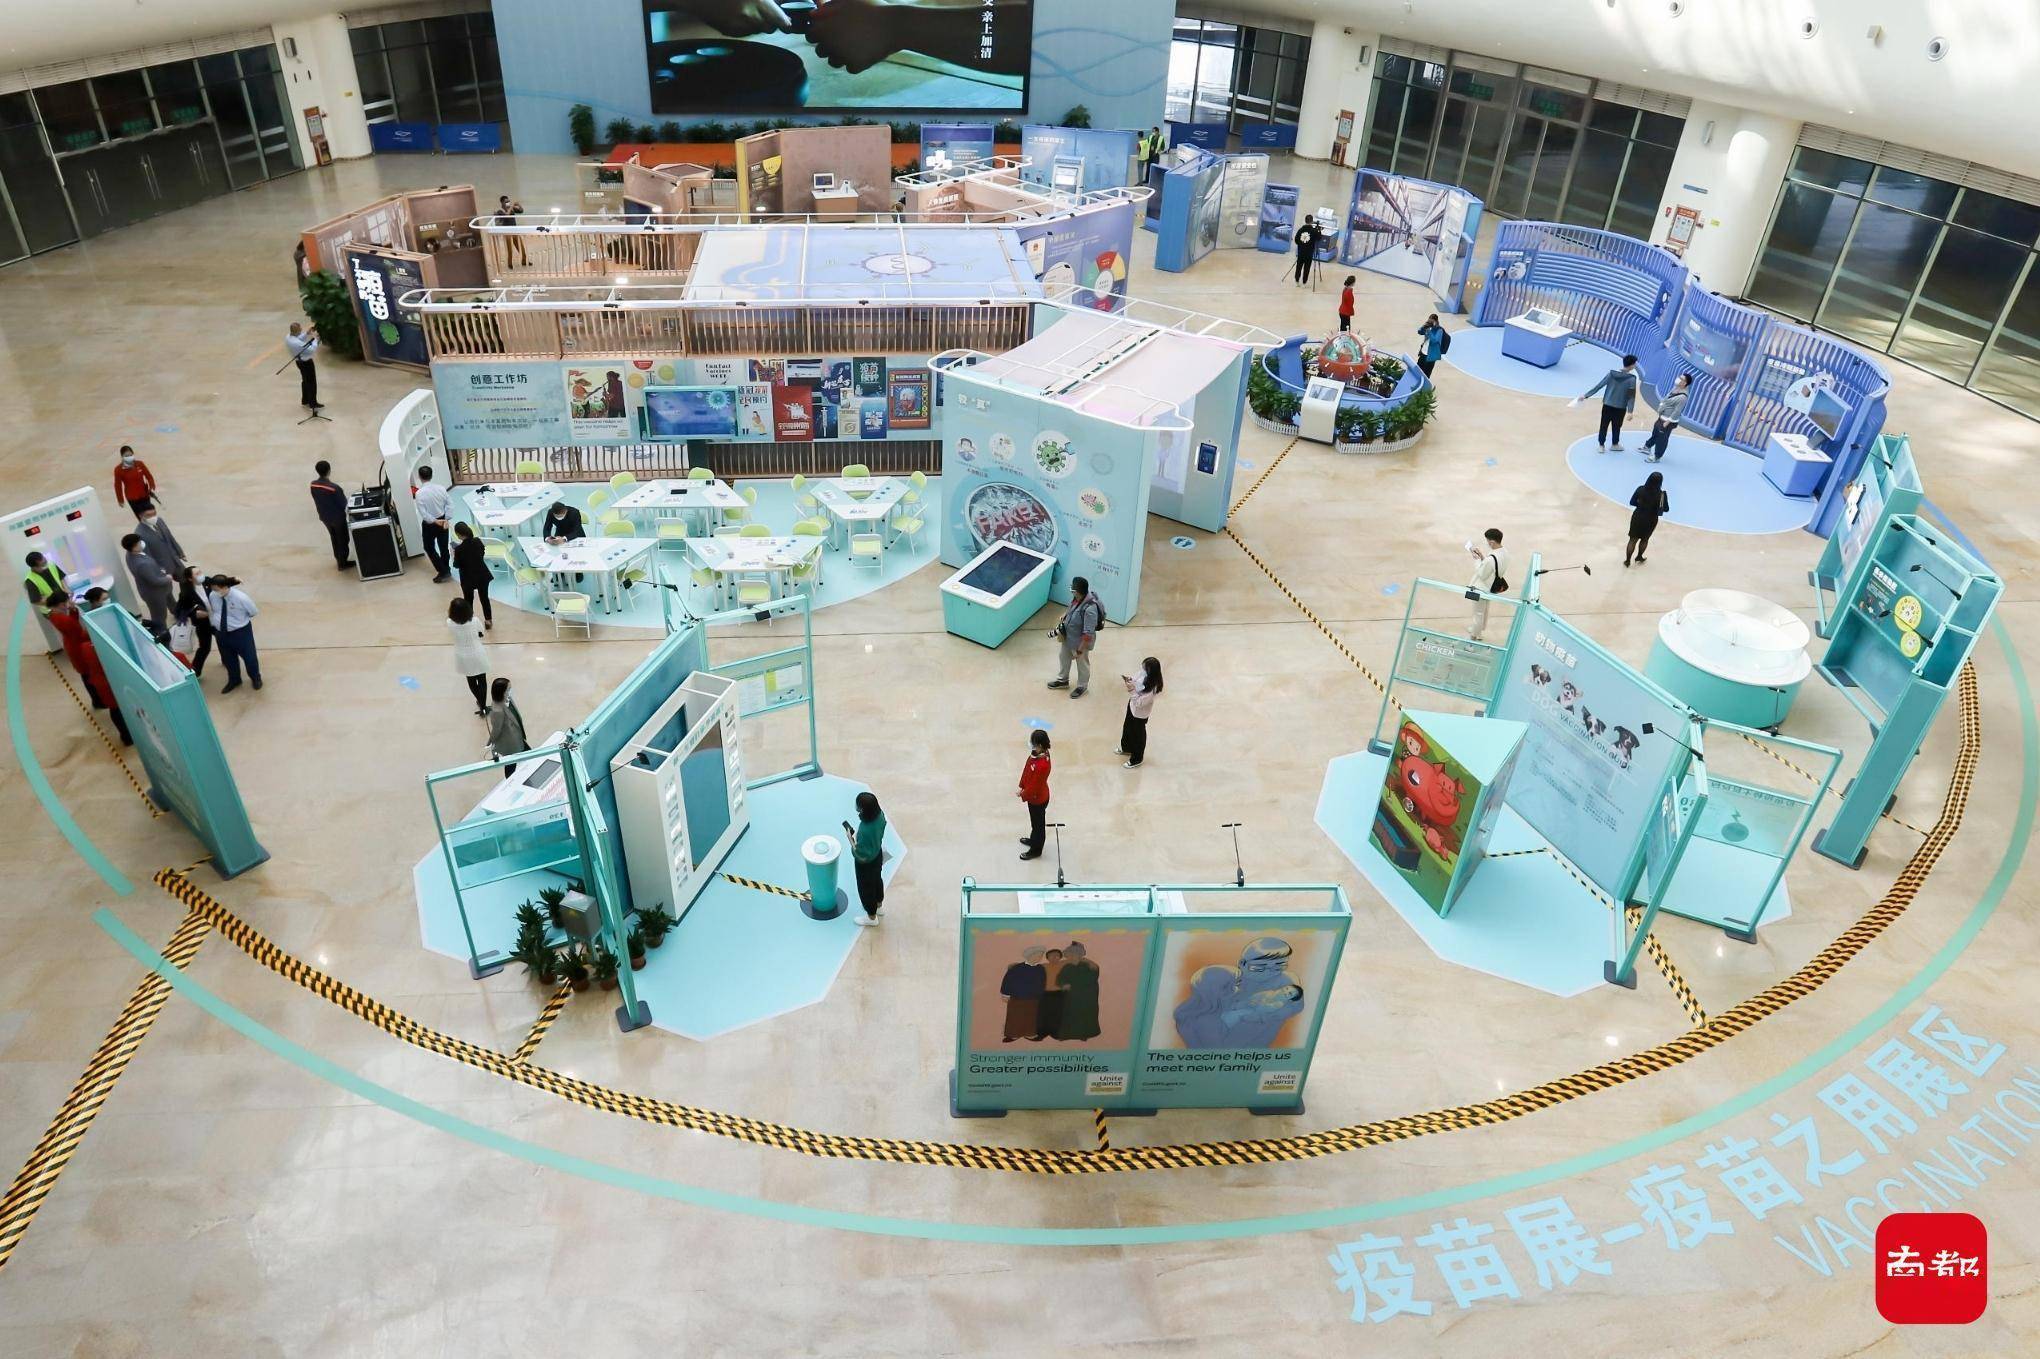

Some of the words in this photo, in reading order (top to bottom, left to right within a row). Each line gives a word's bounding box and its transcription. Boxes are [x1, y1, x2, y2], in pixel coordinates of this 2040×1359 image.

[470, 373, 528, 385] 创意工作坊
[1415, 642, 1455, 656] CHICKEN
[1531, 689, 1558, 717] DOG
[1559, 713, 1609, 755] VACCINATION
[970, 1053, 1026, 1064] Stronger
[1030, 1053, 1095, 1063] immunity
[1147, 1052, 1175, 1062] The
[1176, 1052, 1232, 1062] vaccine
[1234, 1051, 1272, 1062] helps
[1274, 1052, 1292, 1060] us
[969, 1064, 1024, 1074] Greater
[1026, 1064, 1109, 1075] possibilities
[1146, 1064, 1184, 1073] meet
[1186, 1064, 1216, 1072] new
[1218, 1062, 1262, 1073] family
